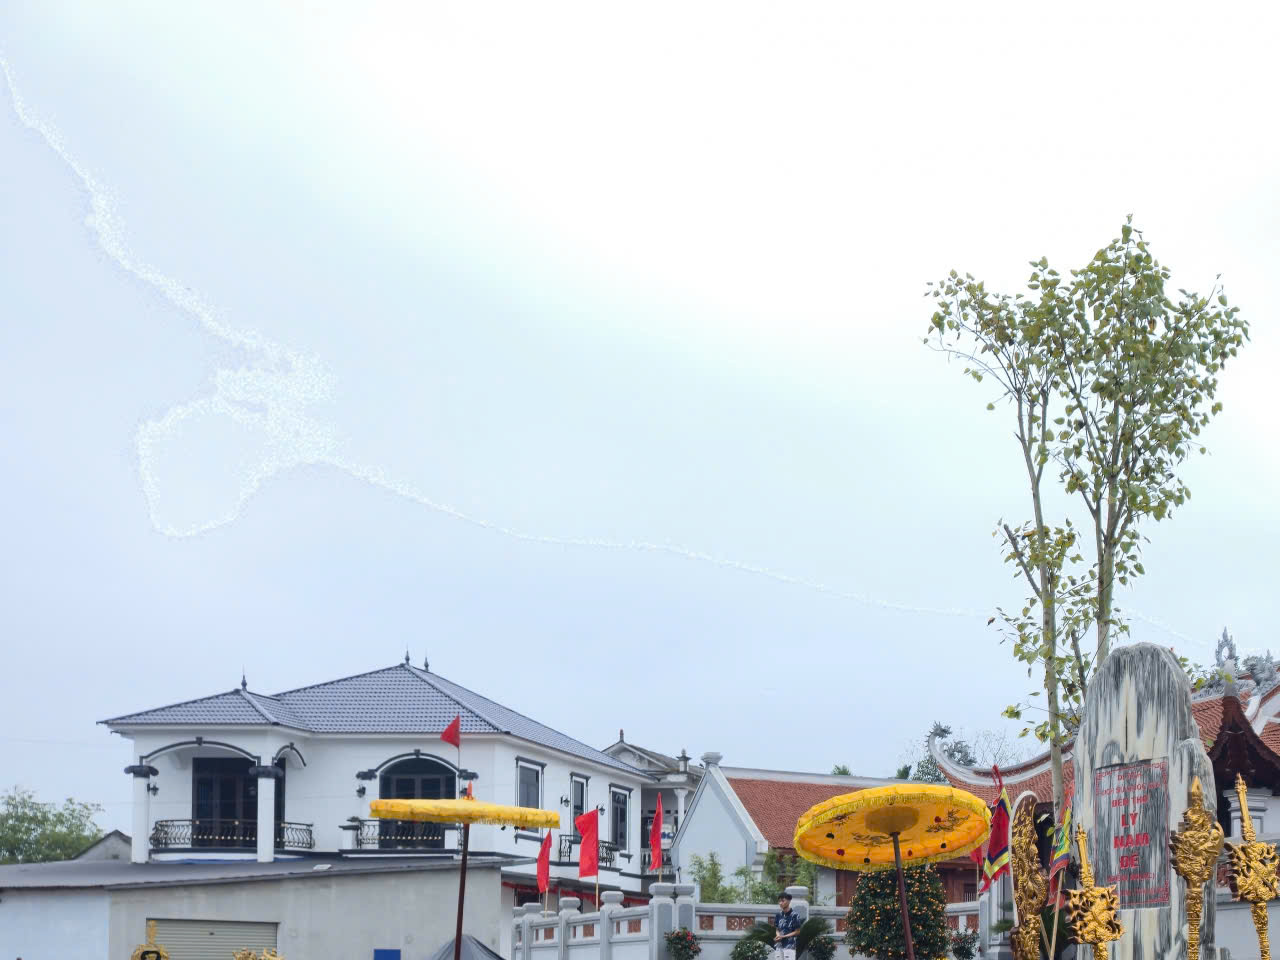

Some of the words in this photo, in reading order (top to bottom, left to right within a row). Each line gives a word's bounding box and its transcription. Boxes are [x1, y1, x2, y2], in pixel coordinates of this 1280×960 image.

[1121, 810, 1138, 828] LÝ
[1113, 832, 1150, 849] NAM
[1120, 851, 1139, 869] ĐẾ
